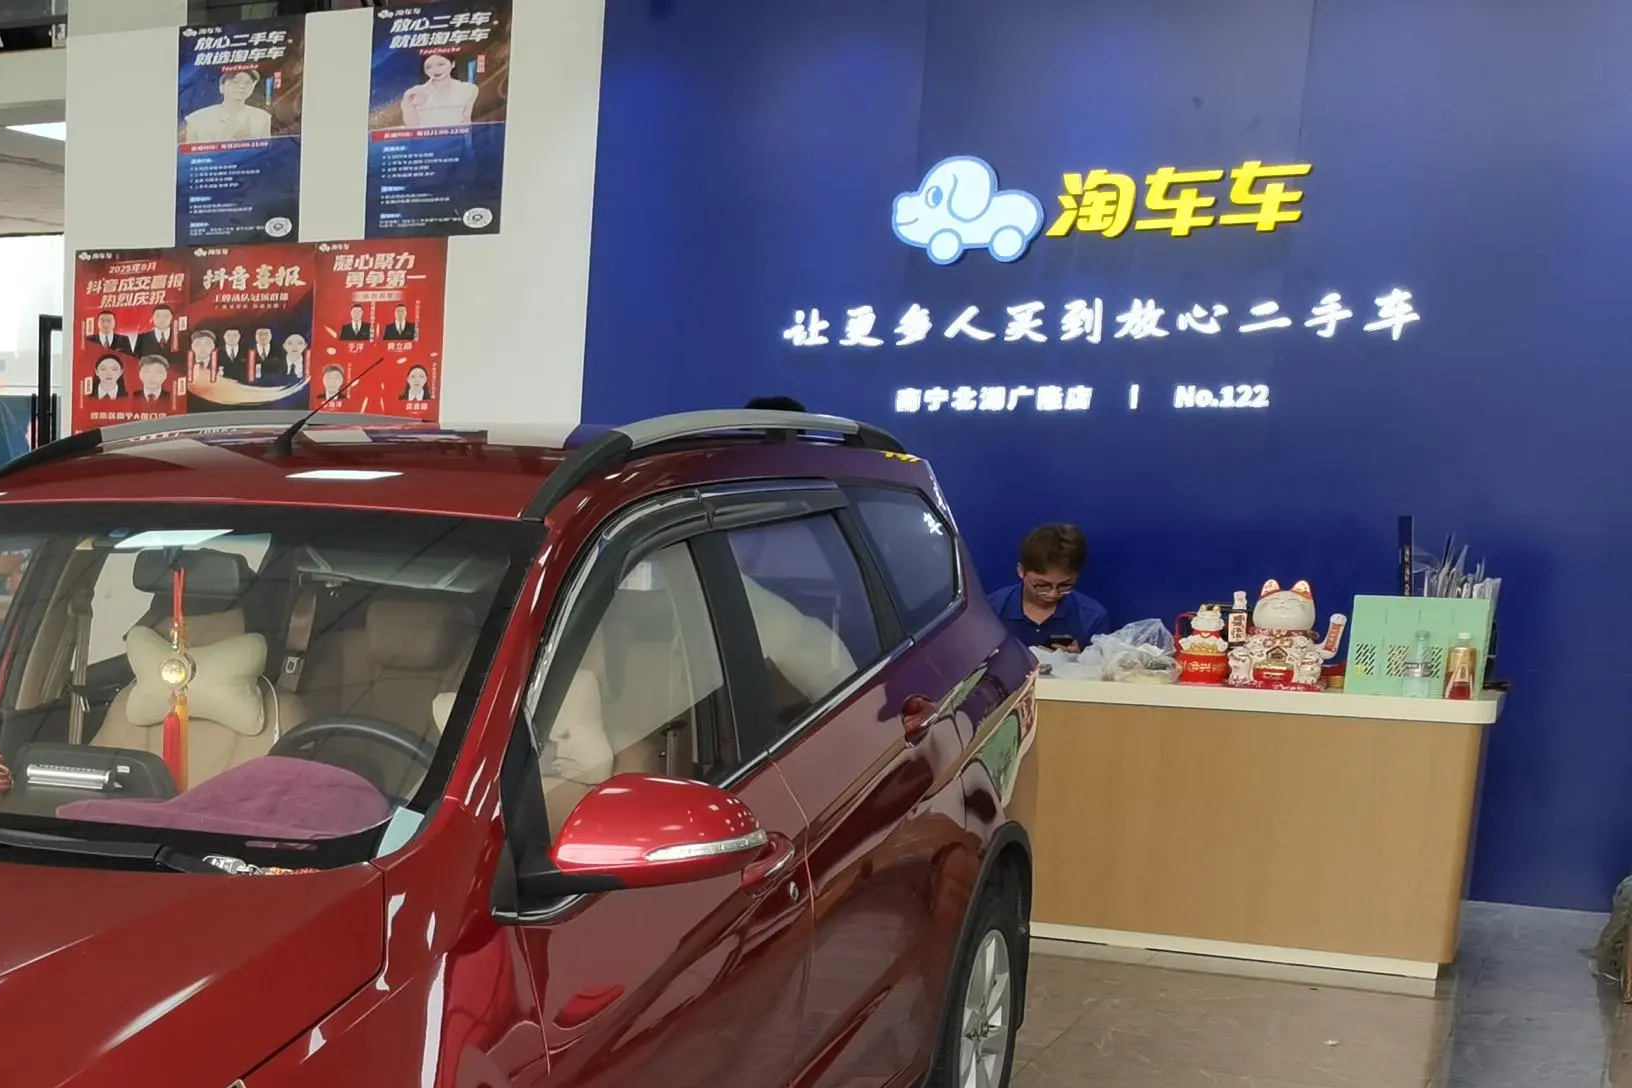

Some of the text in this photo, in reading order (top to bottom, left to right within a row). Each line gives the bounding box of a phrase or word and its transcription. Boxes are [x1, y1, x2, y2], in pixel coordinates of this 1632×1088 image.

[390, 12, 492, 33] 放心二手车
[194, 30, 287, 51] 放心二手车
[1045, 160, 1313, 239] 淘车车
[333, 252, 415, 271] 凝心聚力
[203, 264, 307, 290] 抖音喜报
[100, 290, 166, 308] 热烈庆祝
[783, 288, 1421, 348] 让更多人买到放心二手车
[1174, 384, 1270, 408] No.122
